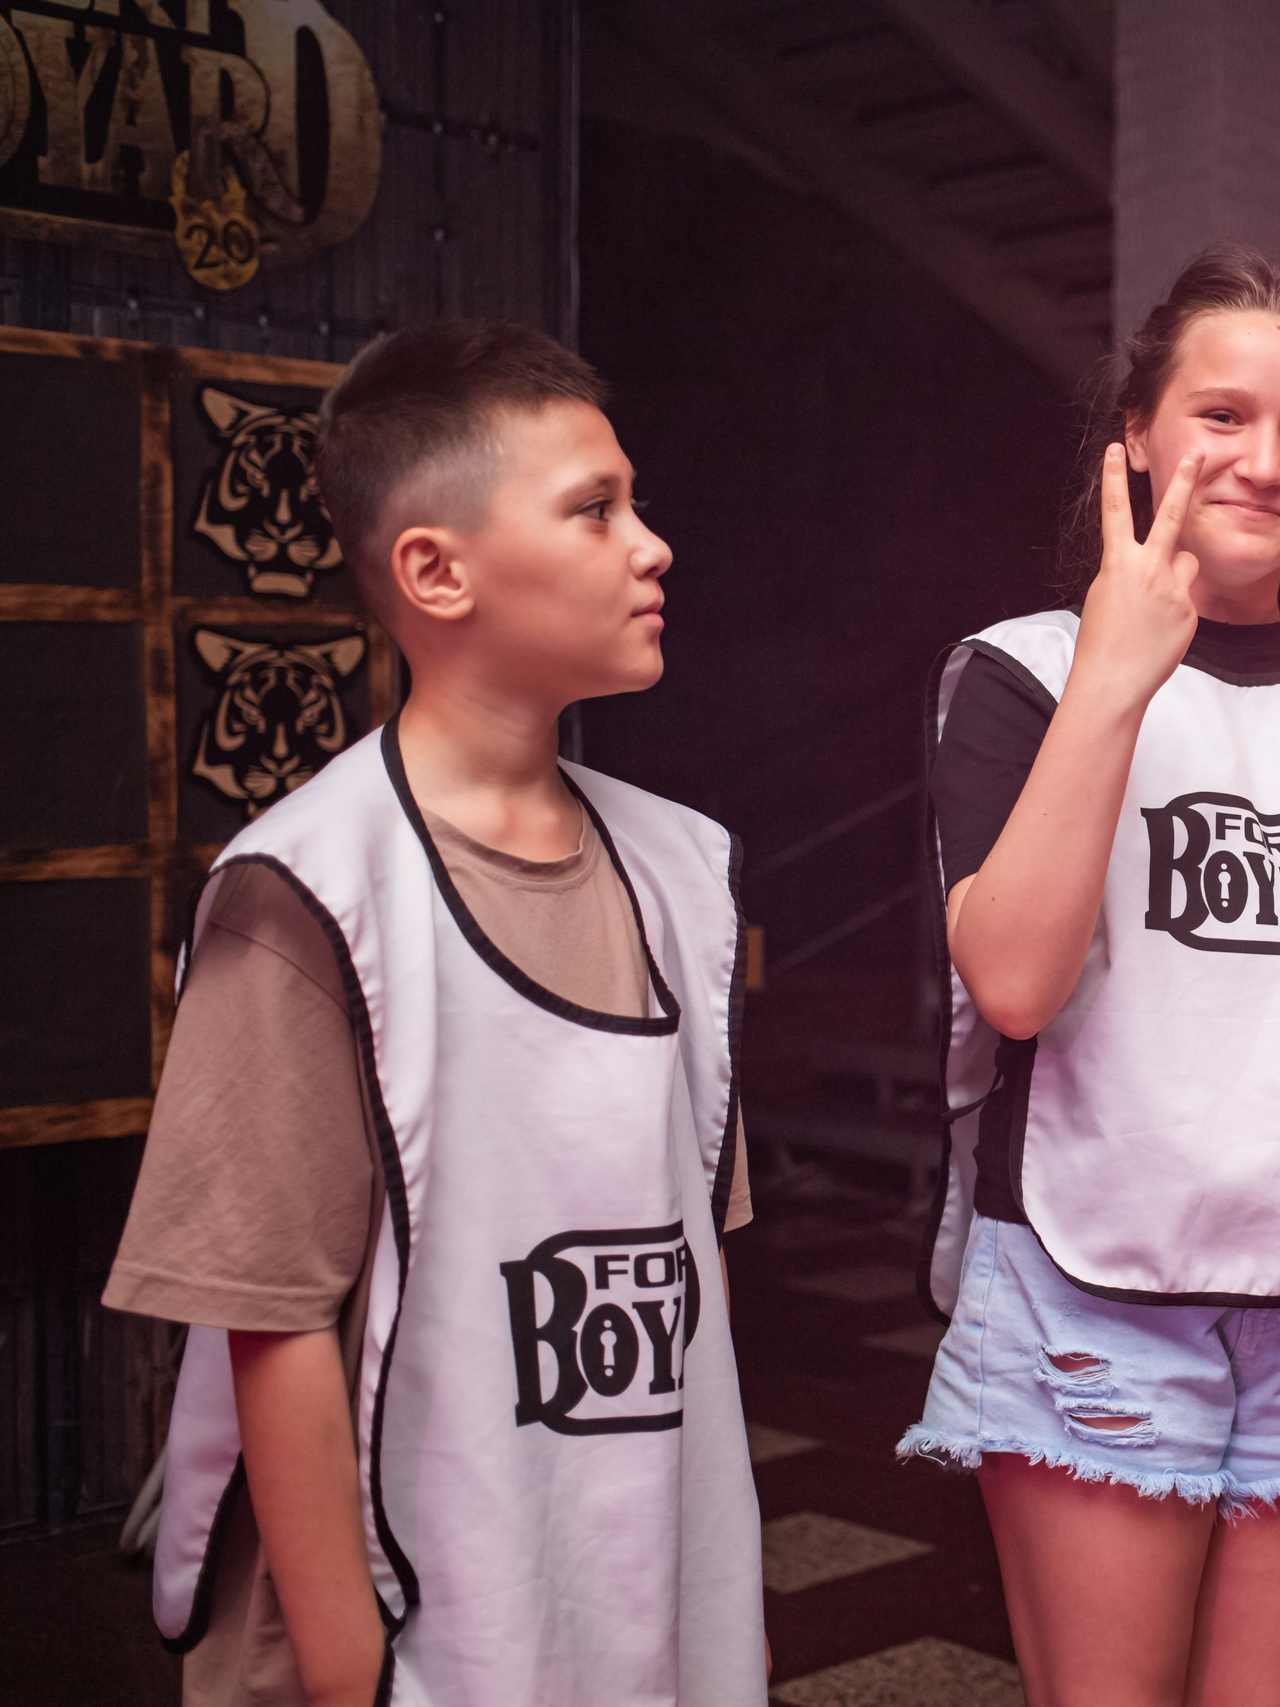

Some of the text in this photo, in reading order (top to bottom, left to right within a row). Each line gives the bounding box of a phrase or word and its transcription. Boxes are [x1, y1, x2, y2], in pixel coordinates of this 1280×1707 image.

[0, 0, 386, 258] YARD
[184, 219, 257, 270] 20
[499, 1255, 701, 1428] BOY
